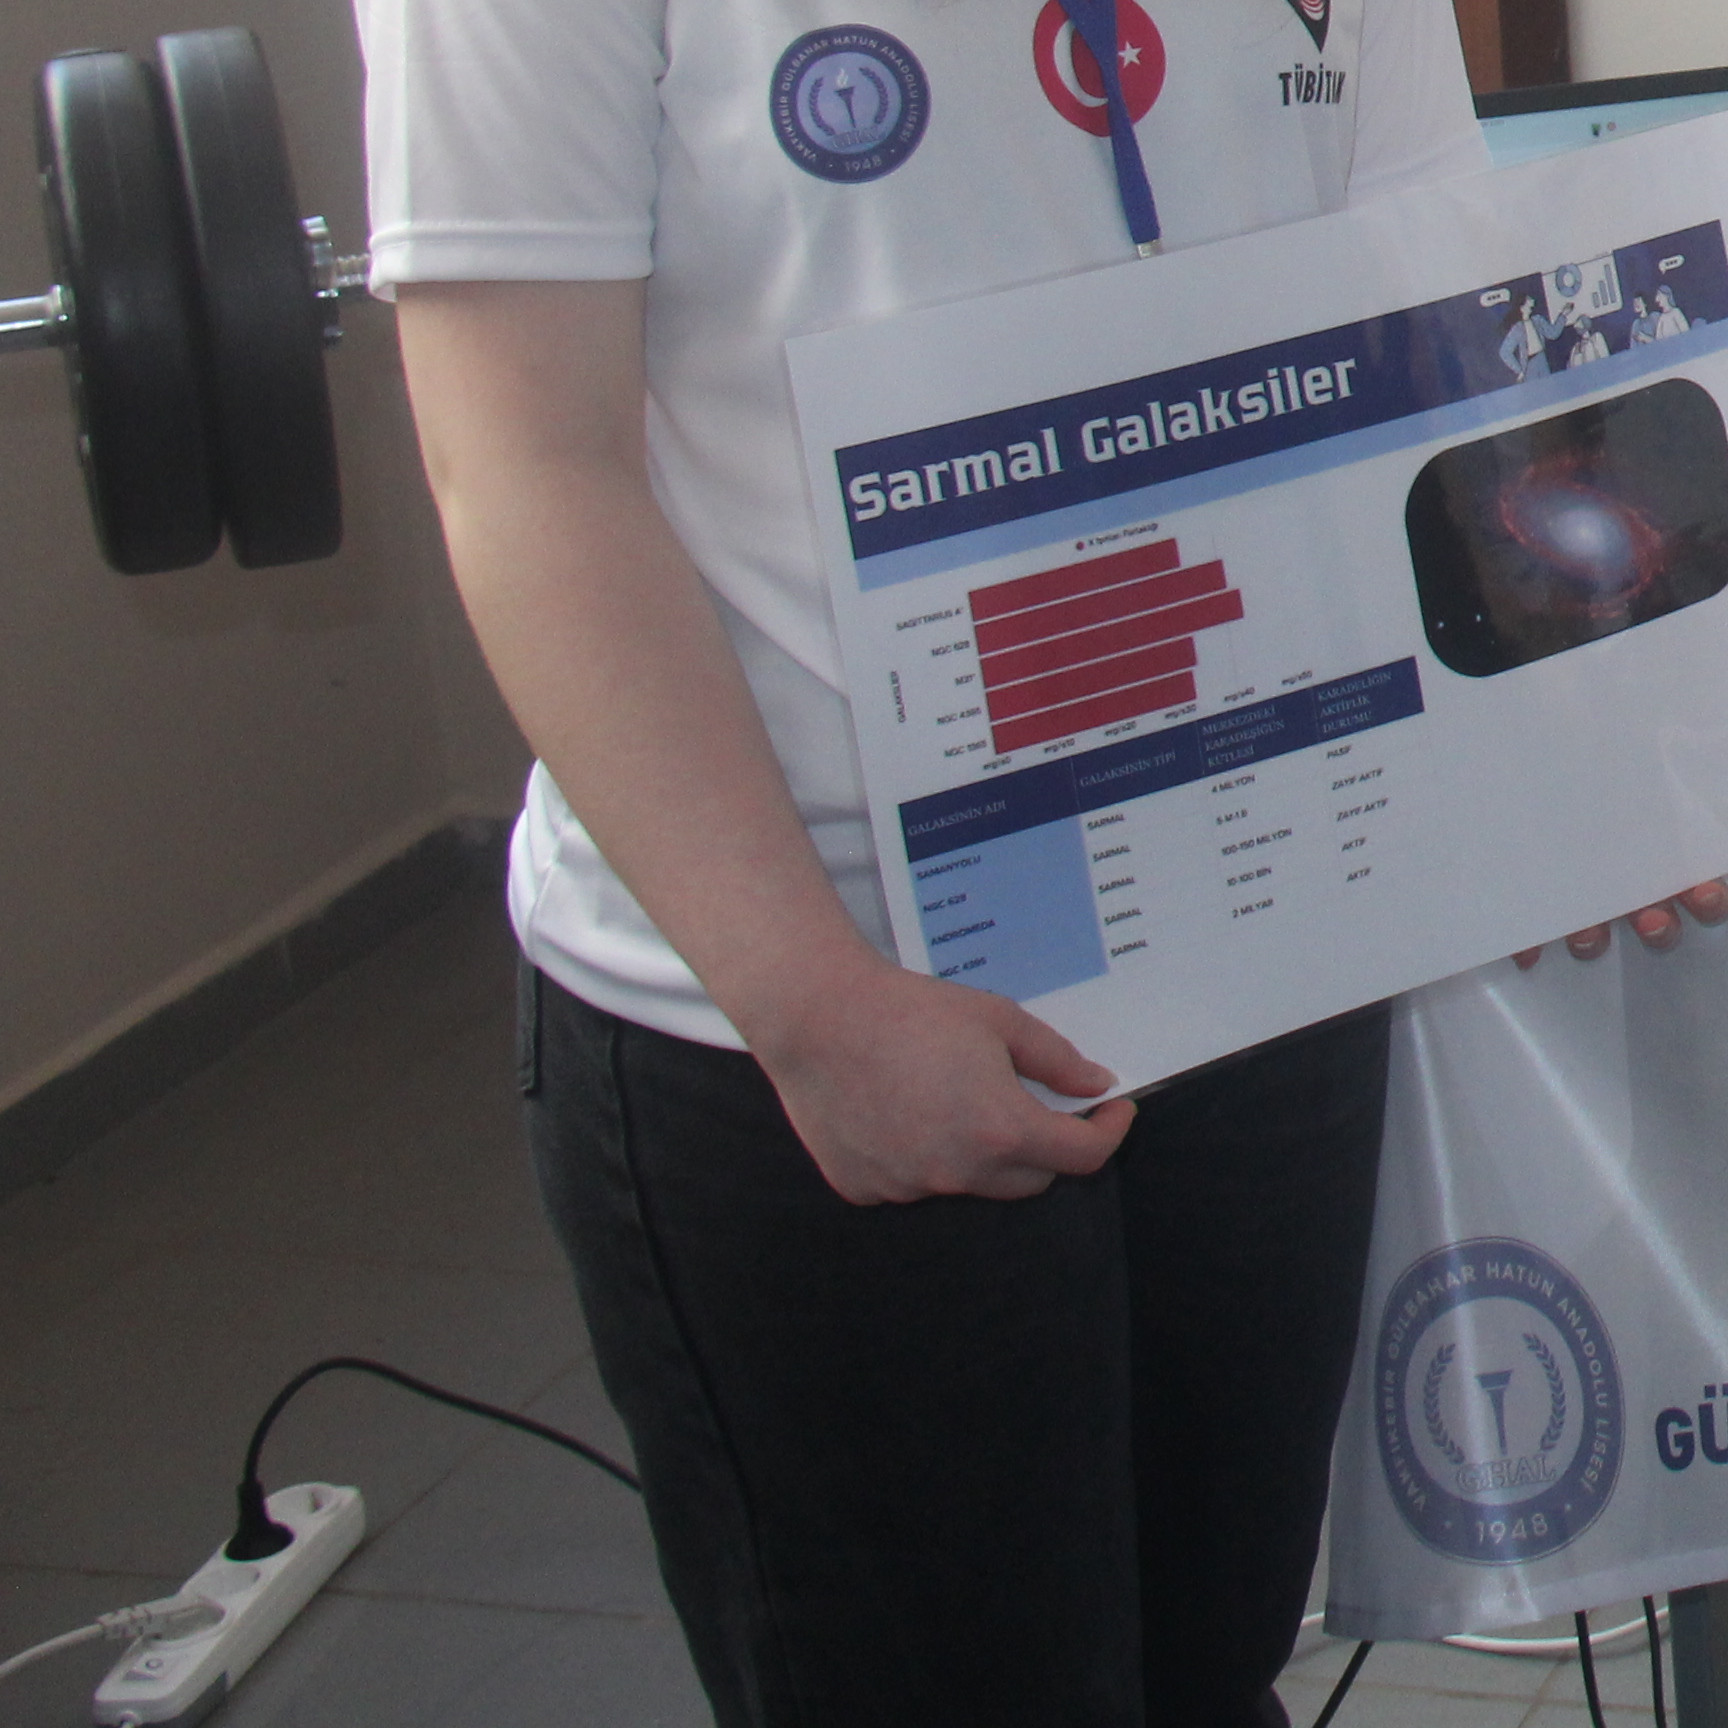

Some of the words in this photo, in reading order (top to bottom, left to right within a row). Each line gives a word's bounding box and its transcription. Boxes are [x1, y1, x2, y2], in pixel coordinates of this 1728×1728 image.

[849, 427, 1062, 522] Sarmal
[1082, 359, 1355, 462] Galaksiler
[1486, 1261, 1555, 1299] HATUN
[1557, 1297, 1604, 1407] ANADOLU
[1475, 1513, 1549, 1544] 1948
